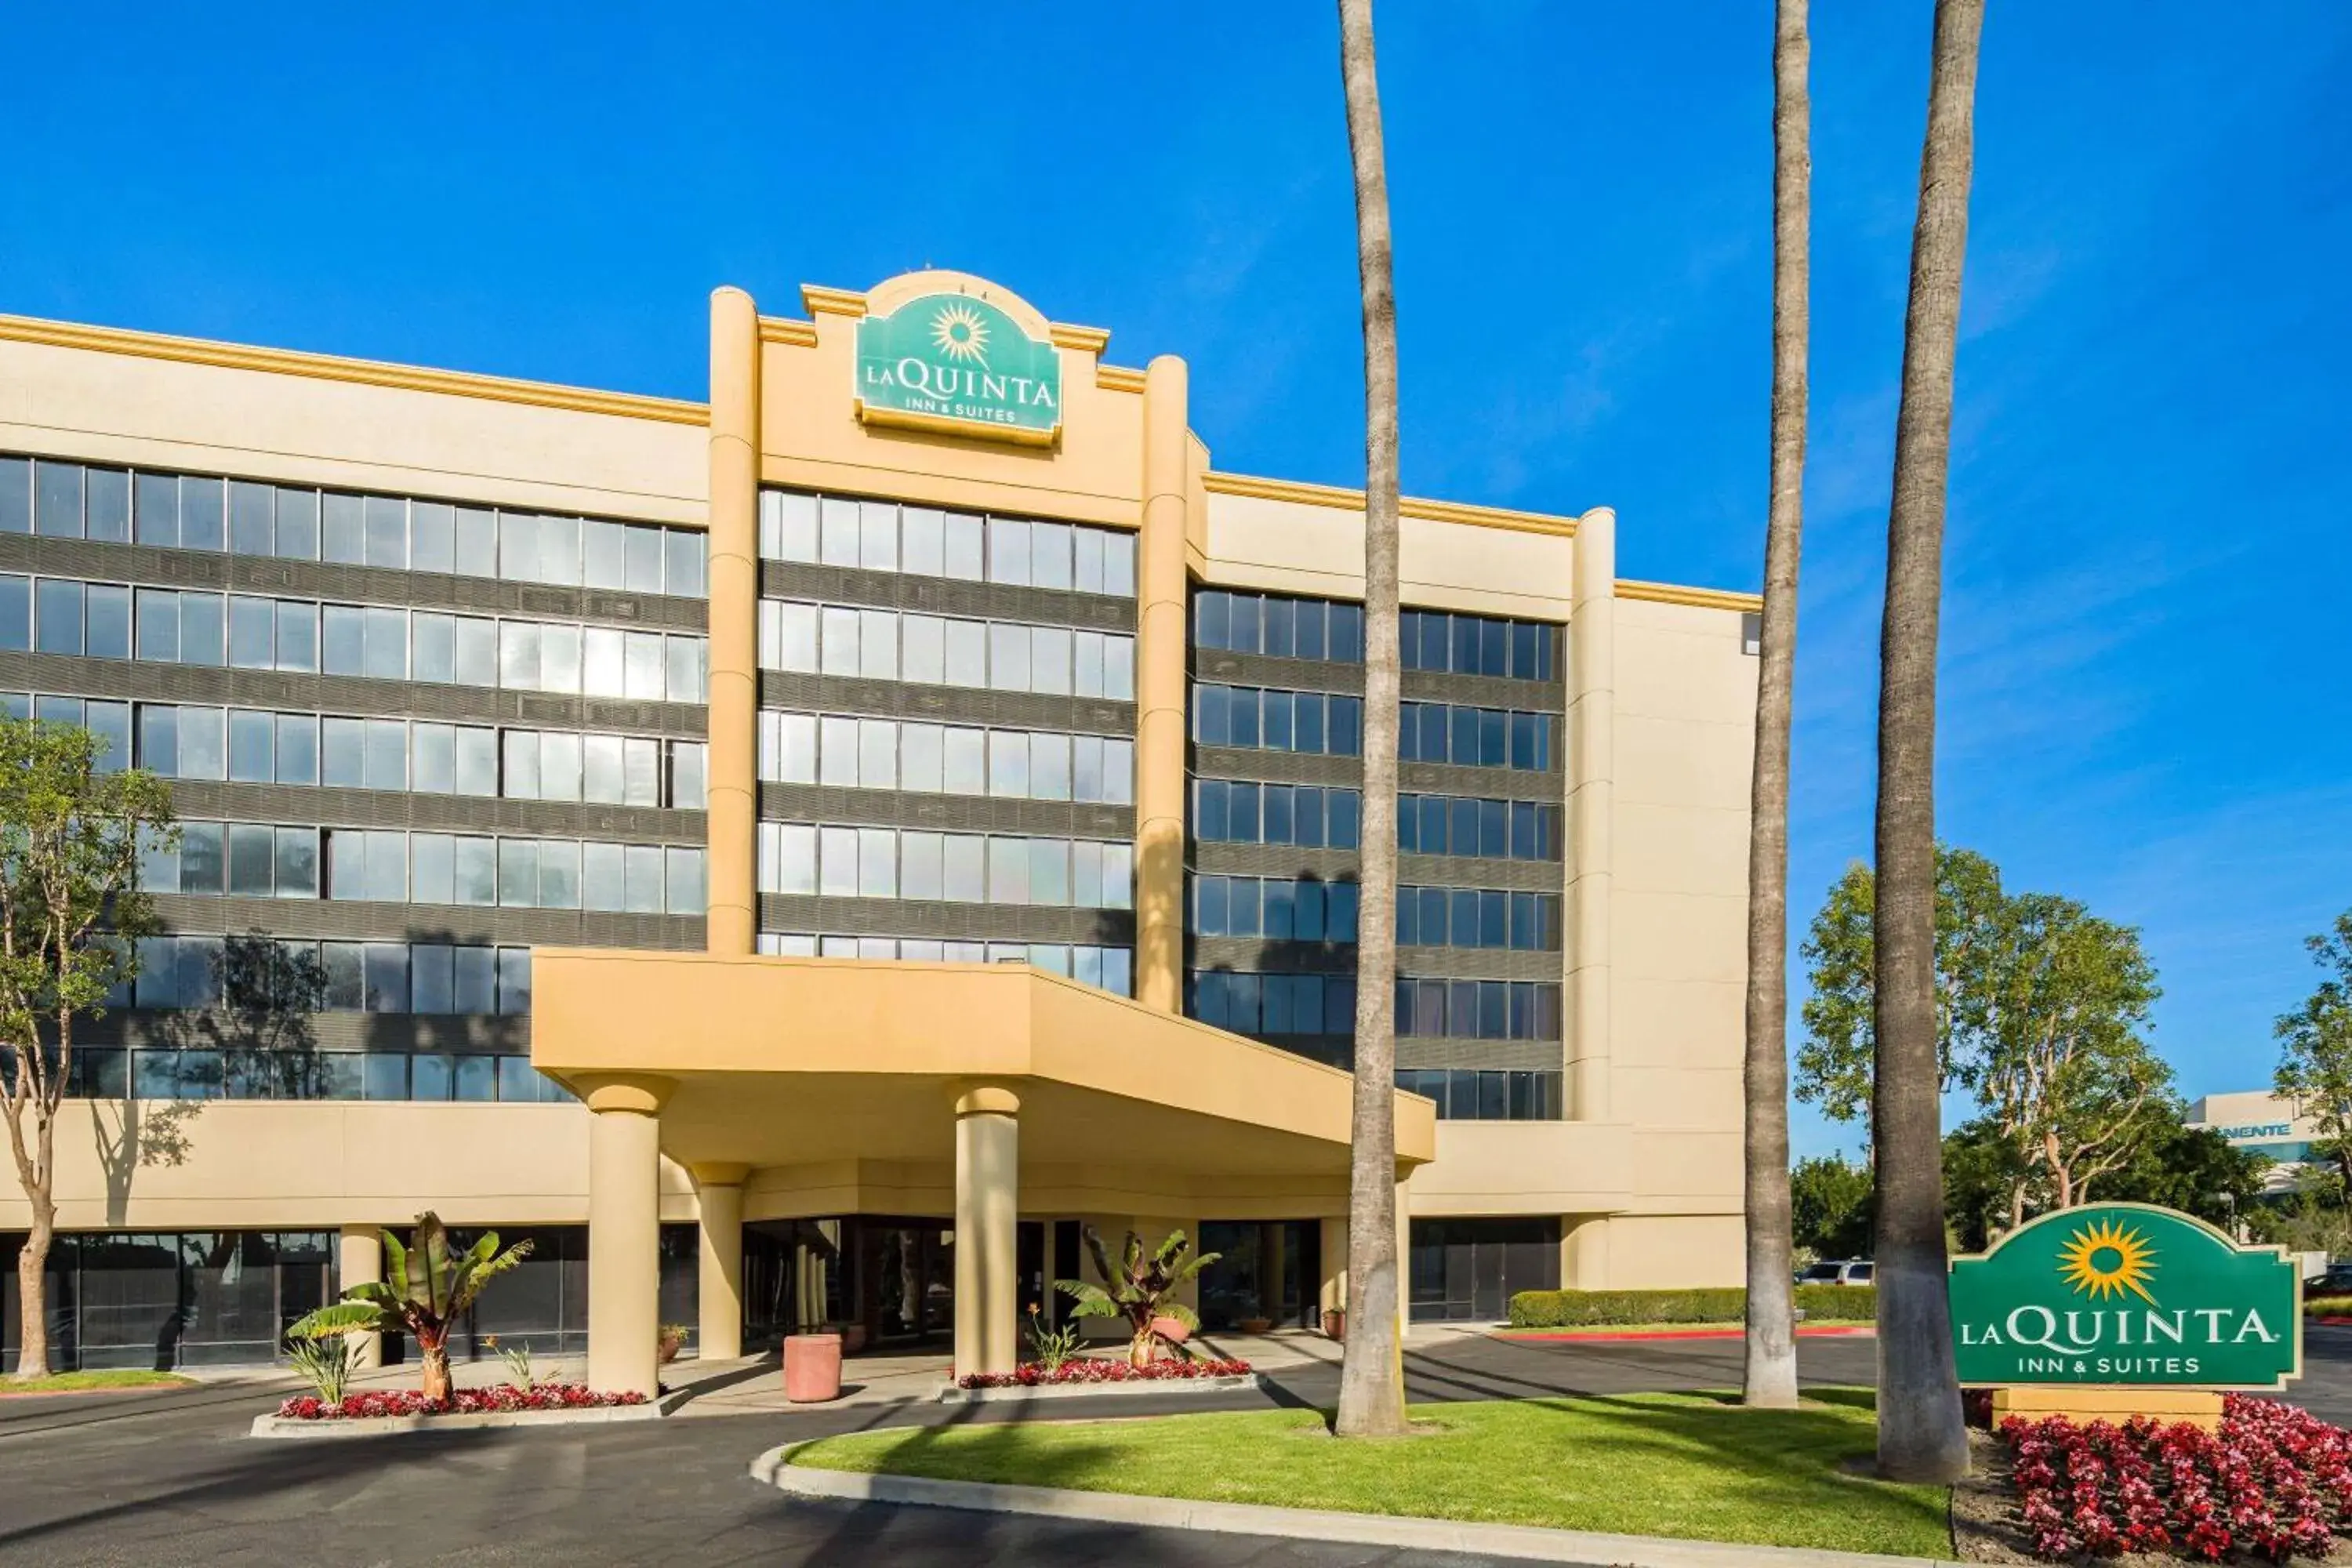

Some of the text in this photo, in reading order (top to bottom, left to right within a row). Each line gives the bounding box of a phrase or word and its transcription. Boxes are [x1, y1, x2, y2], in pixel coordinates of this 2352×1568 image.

[867, 358, 1056, 408] LA QUINTA
[906, 396, 1016, 423] INN & SUITES
[1961, 1305, 2277, 1355] LA QUINTA
[2019, 1358, 2200, 1373] INN & SUITES
